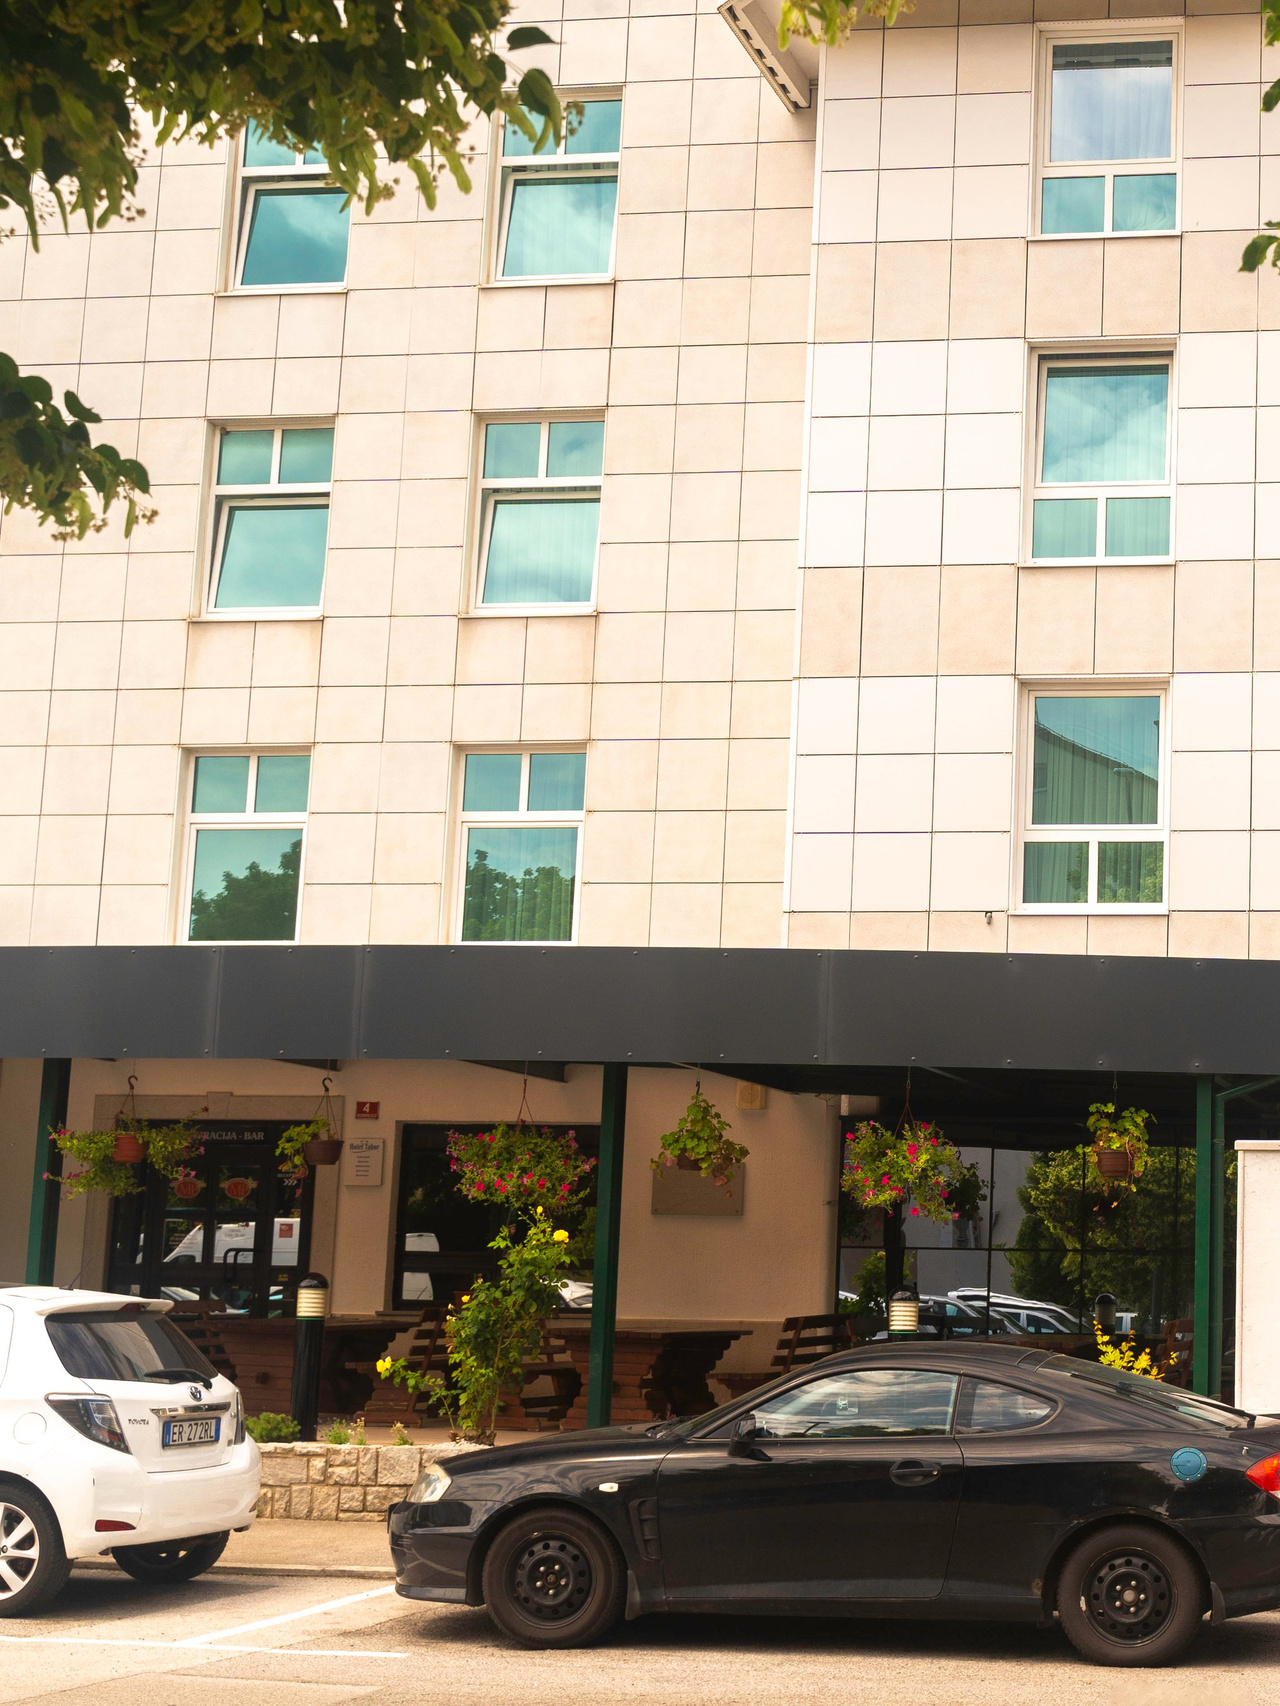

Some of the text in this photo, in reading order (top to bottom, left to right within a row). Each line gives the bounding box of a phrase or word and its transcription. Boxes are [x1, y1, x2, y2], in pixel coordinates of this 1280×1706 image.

[362, 1102, 370, 1113] 4
[244, 1131, 265, 1140] BAR
[171, 1421, 214, 1443] ER 272RL
